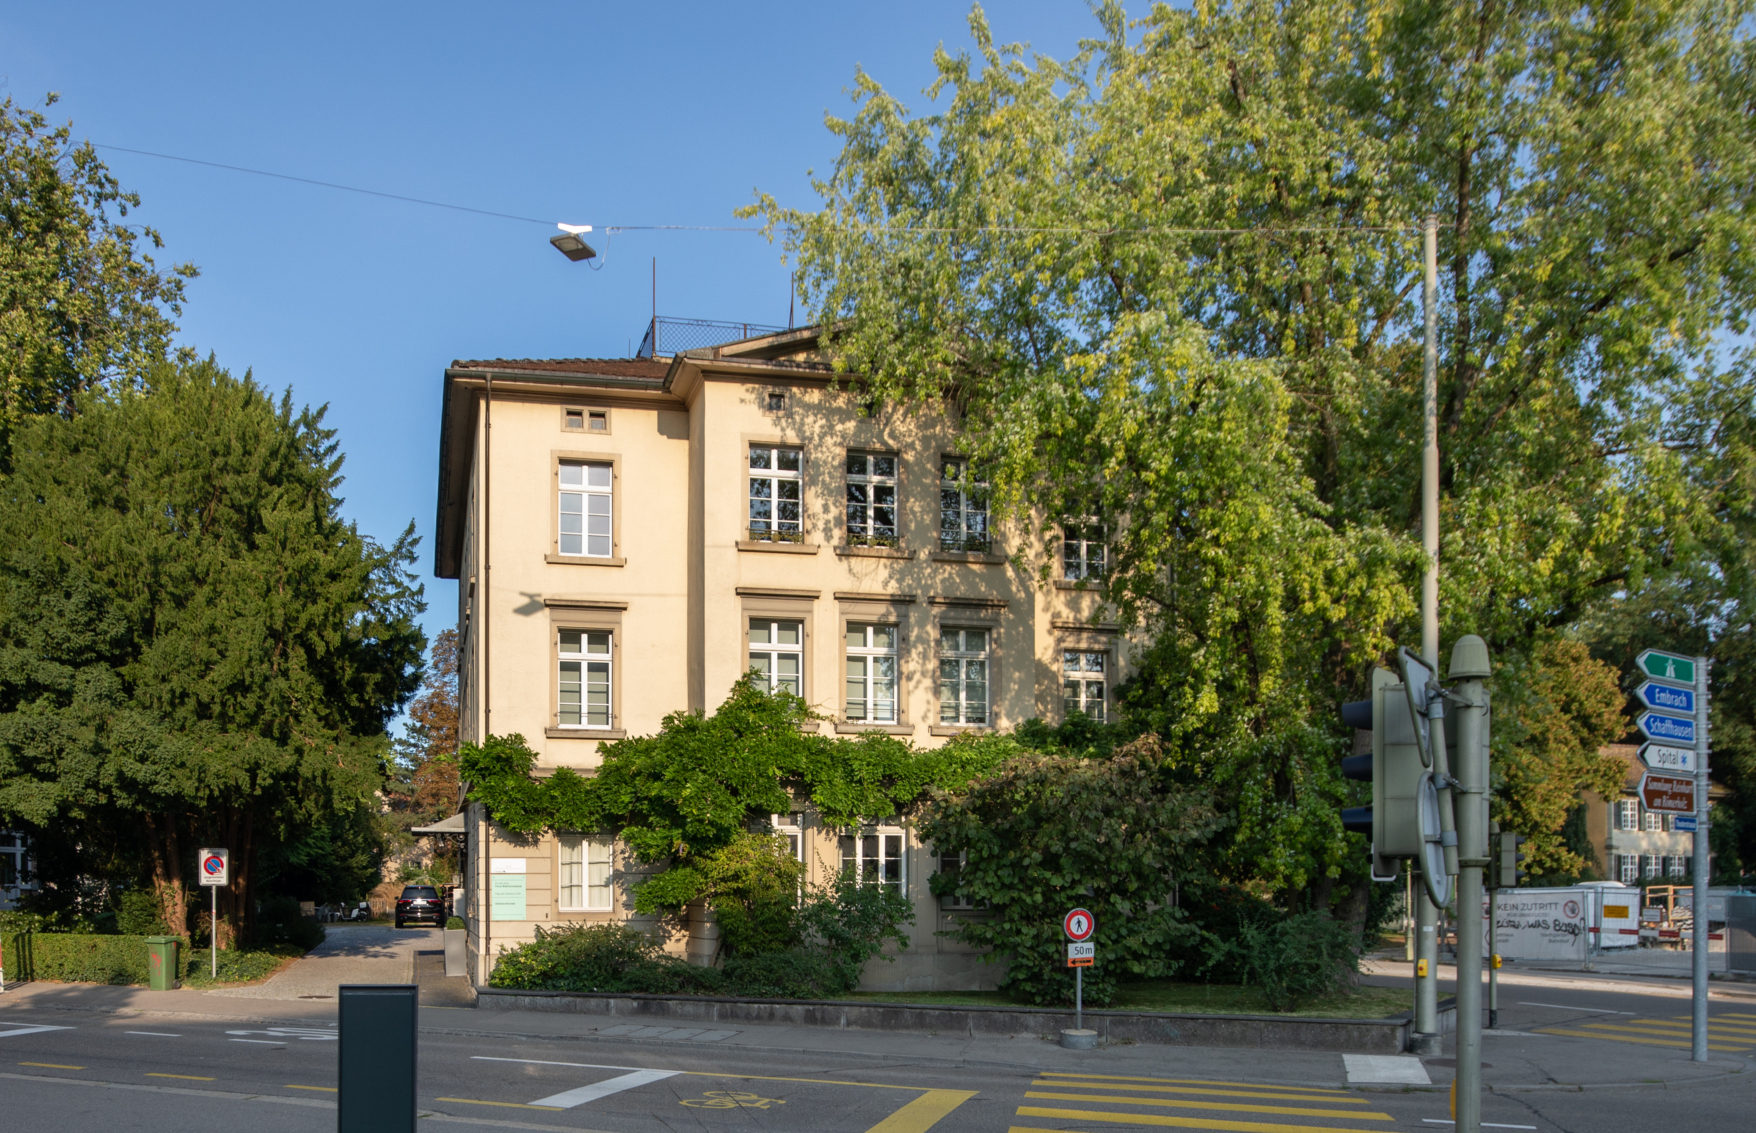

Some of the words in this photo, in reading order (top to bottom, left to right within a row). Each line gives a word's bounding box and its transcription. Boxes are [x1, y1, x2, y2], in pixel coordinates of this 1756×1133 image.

[1655, 688, 1687, 708] Embrach
[1650, 717, 1693, 739] Schaffhausen
[1657, 749, 1678, 767] Spital
[1497, 902, 1518, 911] KEIN
[1520, 902, 1559, 911] ZUTRITT
[1075, 946, 1084, 955] 50
